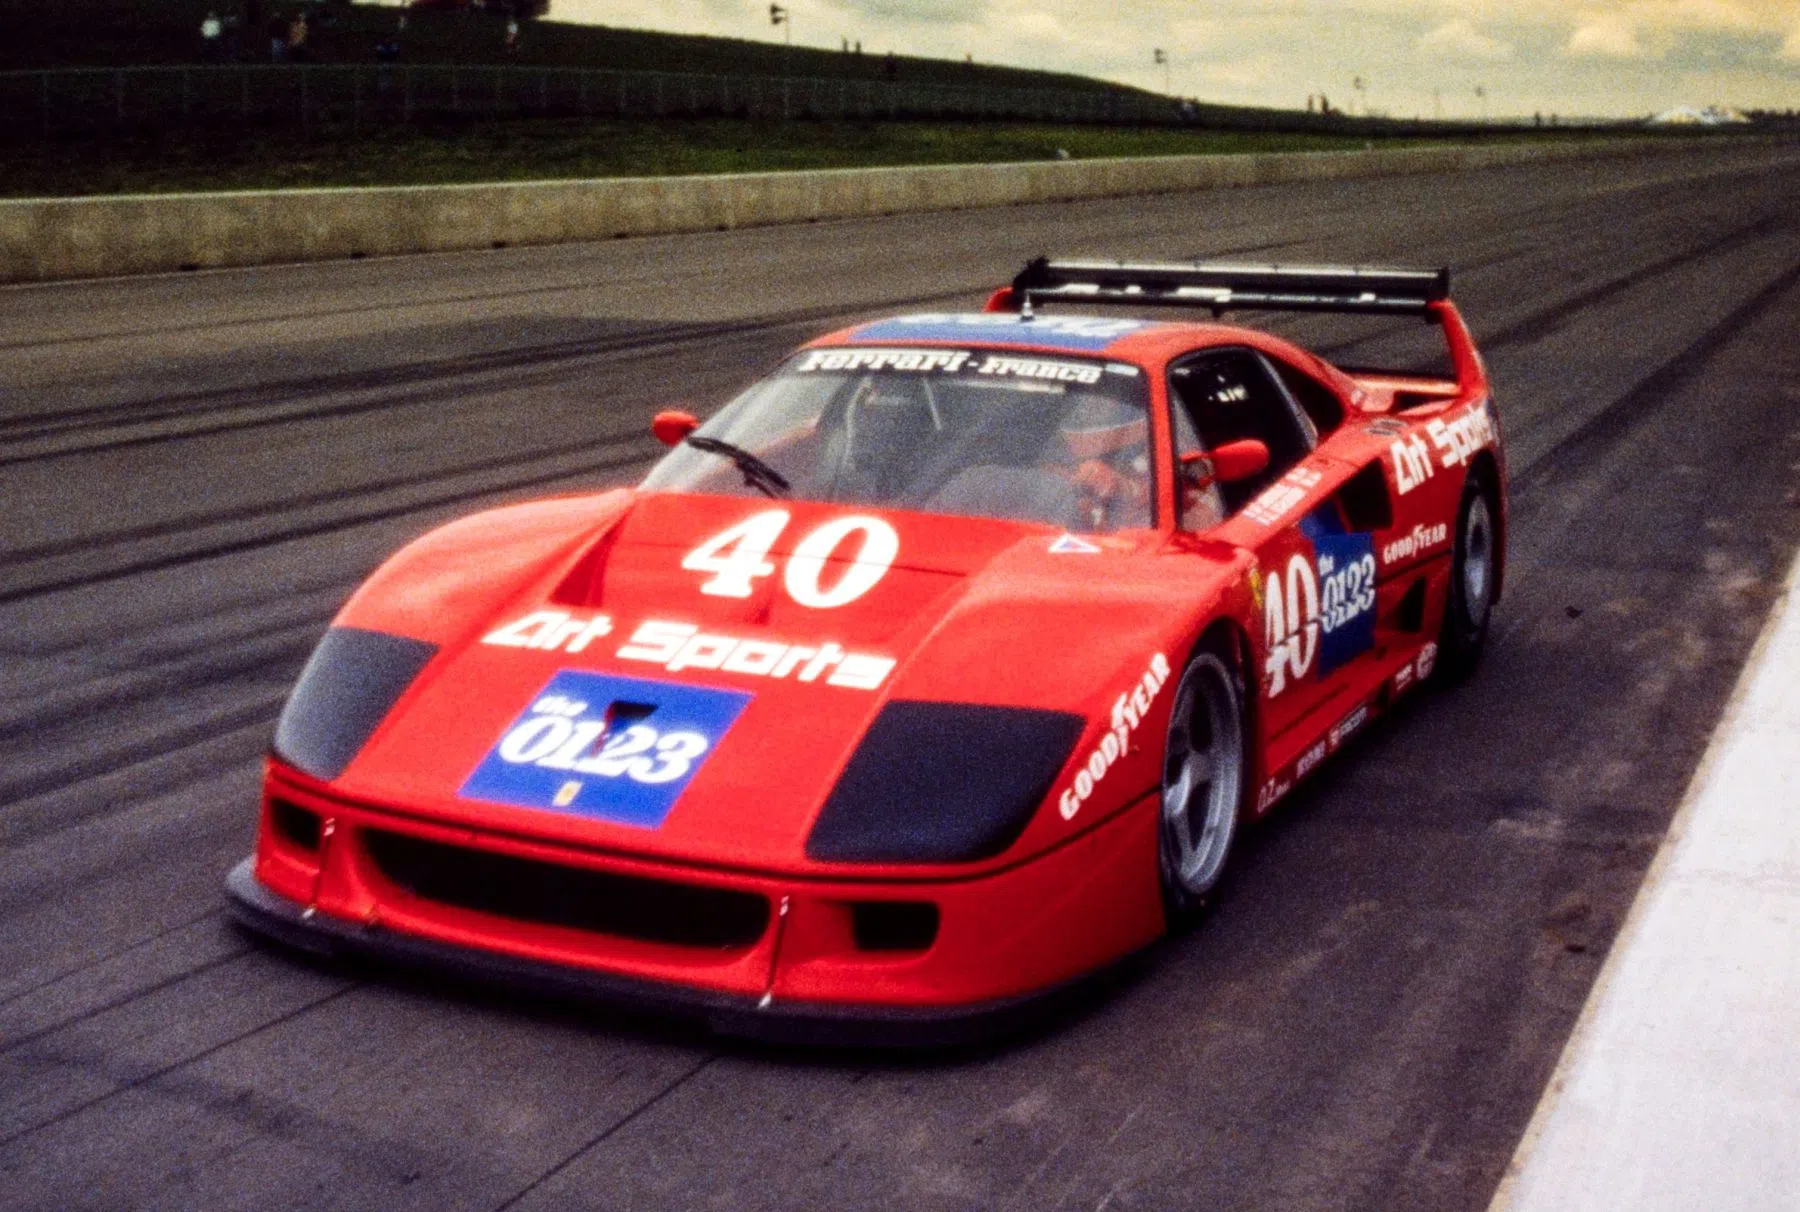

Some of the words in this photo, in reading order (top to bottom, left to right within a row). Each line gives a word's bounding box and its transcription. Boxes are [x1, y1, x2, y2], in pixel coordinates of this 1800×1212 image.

[681, 509, 899, 609] 40
[1383, 523, 1447, 565] GOODYEAR
[1265, 553, 1318, 698] 40
[1322, 553, 1375, 634] 0123
[480, 610, 614, 653] Art
[615, 619, 896, 691] Sports
[499, 715, 707, 784] 0123
[1059, 652, 1170, 821] GOODYEAR
